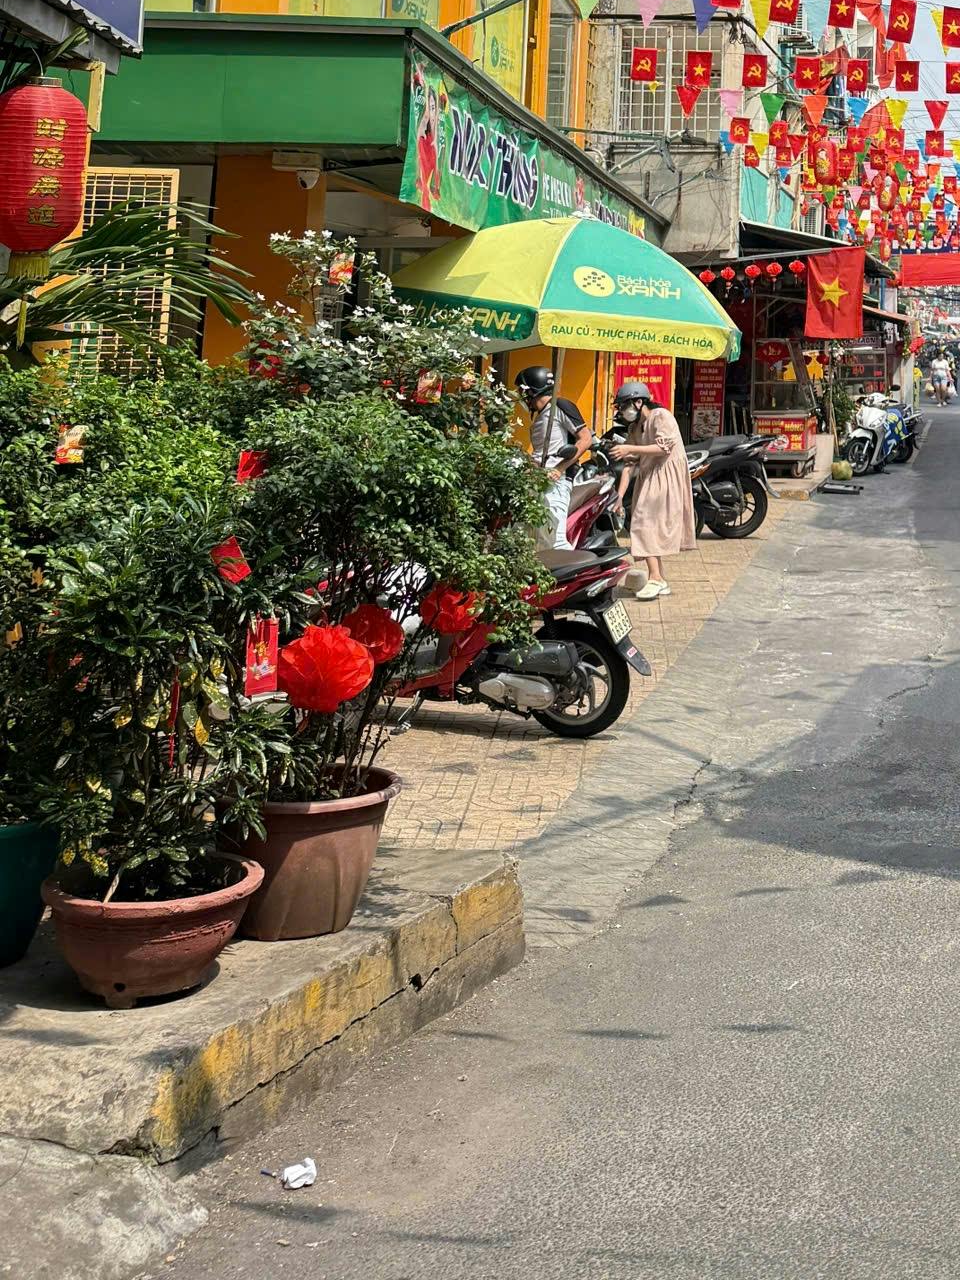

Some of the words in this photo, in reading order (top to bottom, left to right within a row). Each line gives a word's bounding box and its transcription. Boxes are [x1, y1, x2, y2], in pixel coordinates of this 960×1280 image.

[617, 274, 649, 287] Bách
[650, 277, 672, 288] hóa
[617, 284, 681, 300] XANH
[551, 325, 573, 335] RAU
[576, 325, 590, 336] CỦ
[596, 328, 625, 341] THỰC
[663, 332, 690, 346] BÁCH
[692, 334, 713, 349] HÓA
